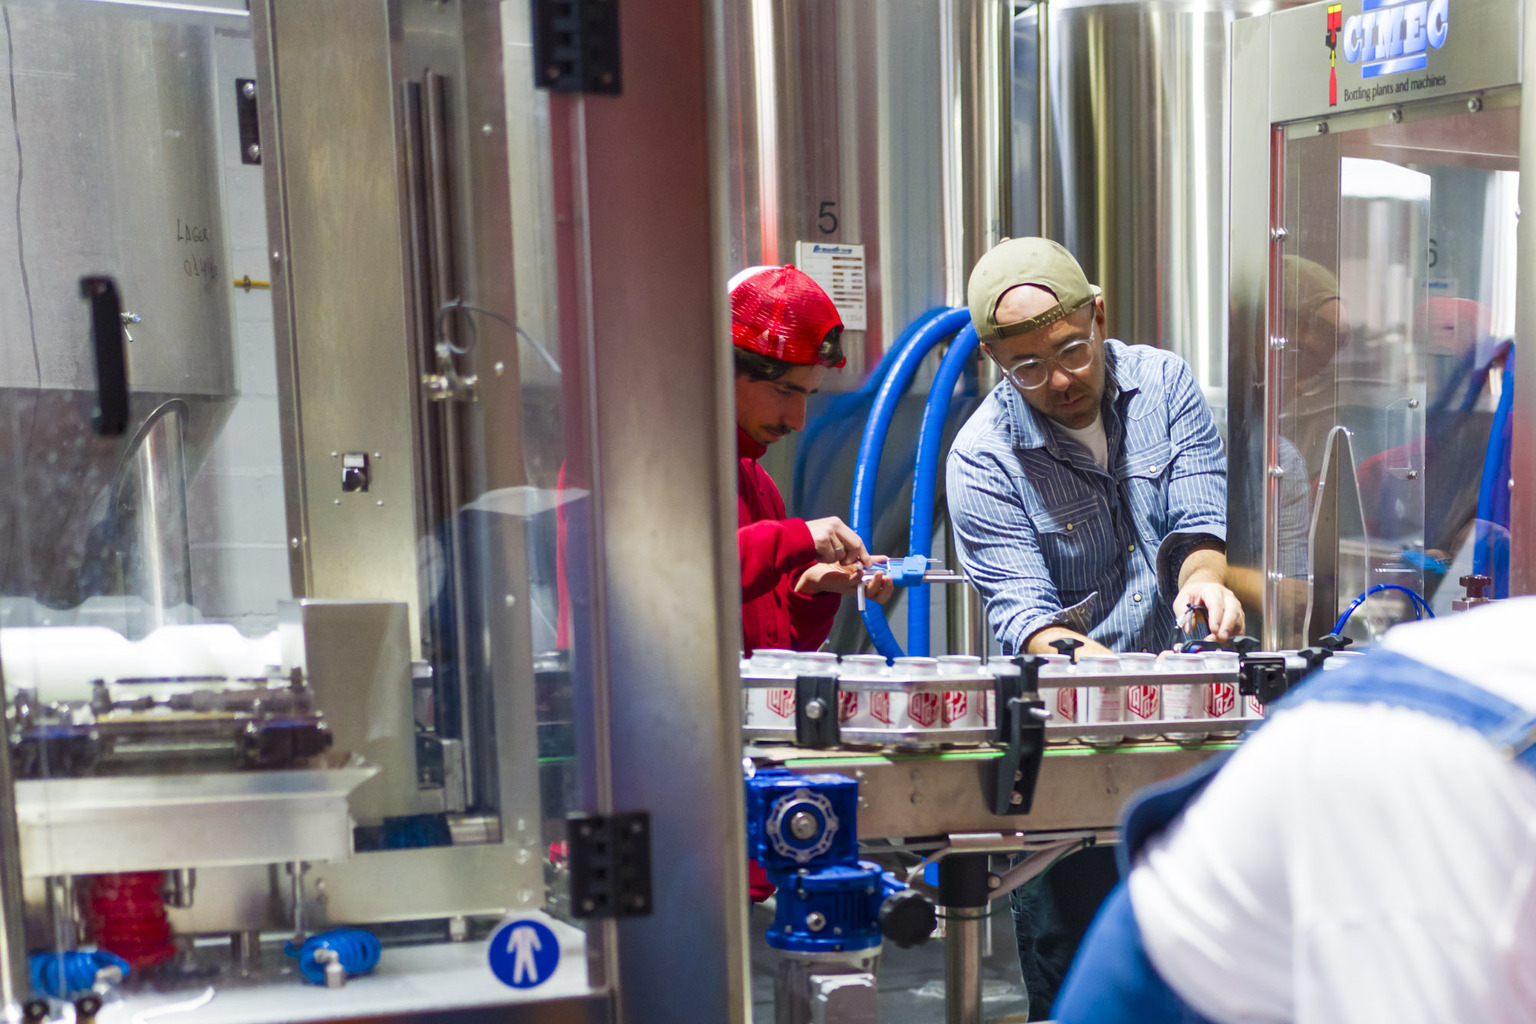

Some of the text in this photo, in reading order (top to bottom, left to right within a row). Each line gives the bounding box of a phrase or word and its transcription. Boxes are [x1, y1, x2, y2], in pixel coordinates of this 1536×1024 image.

[1343, 0, 1449, 64] CIMEC
[1344, 74, 1447, 103] Bottling plants and machines
[818, 202, 838, 234] 5
